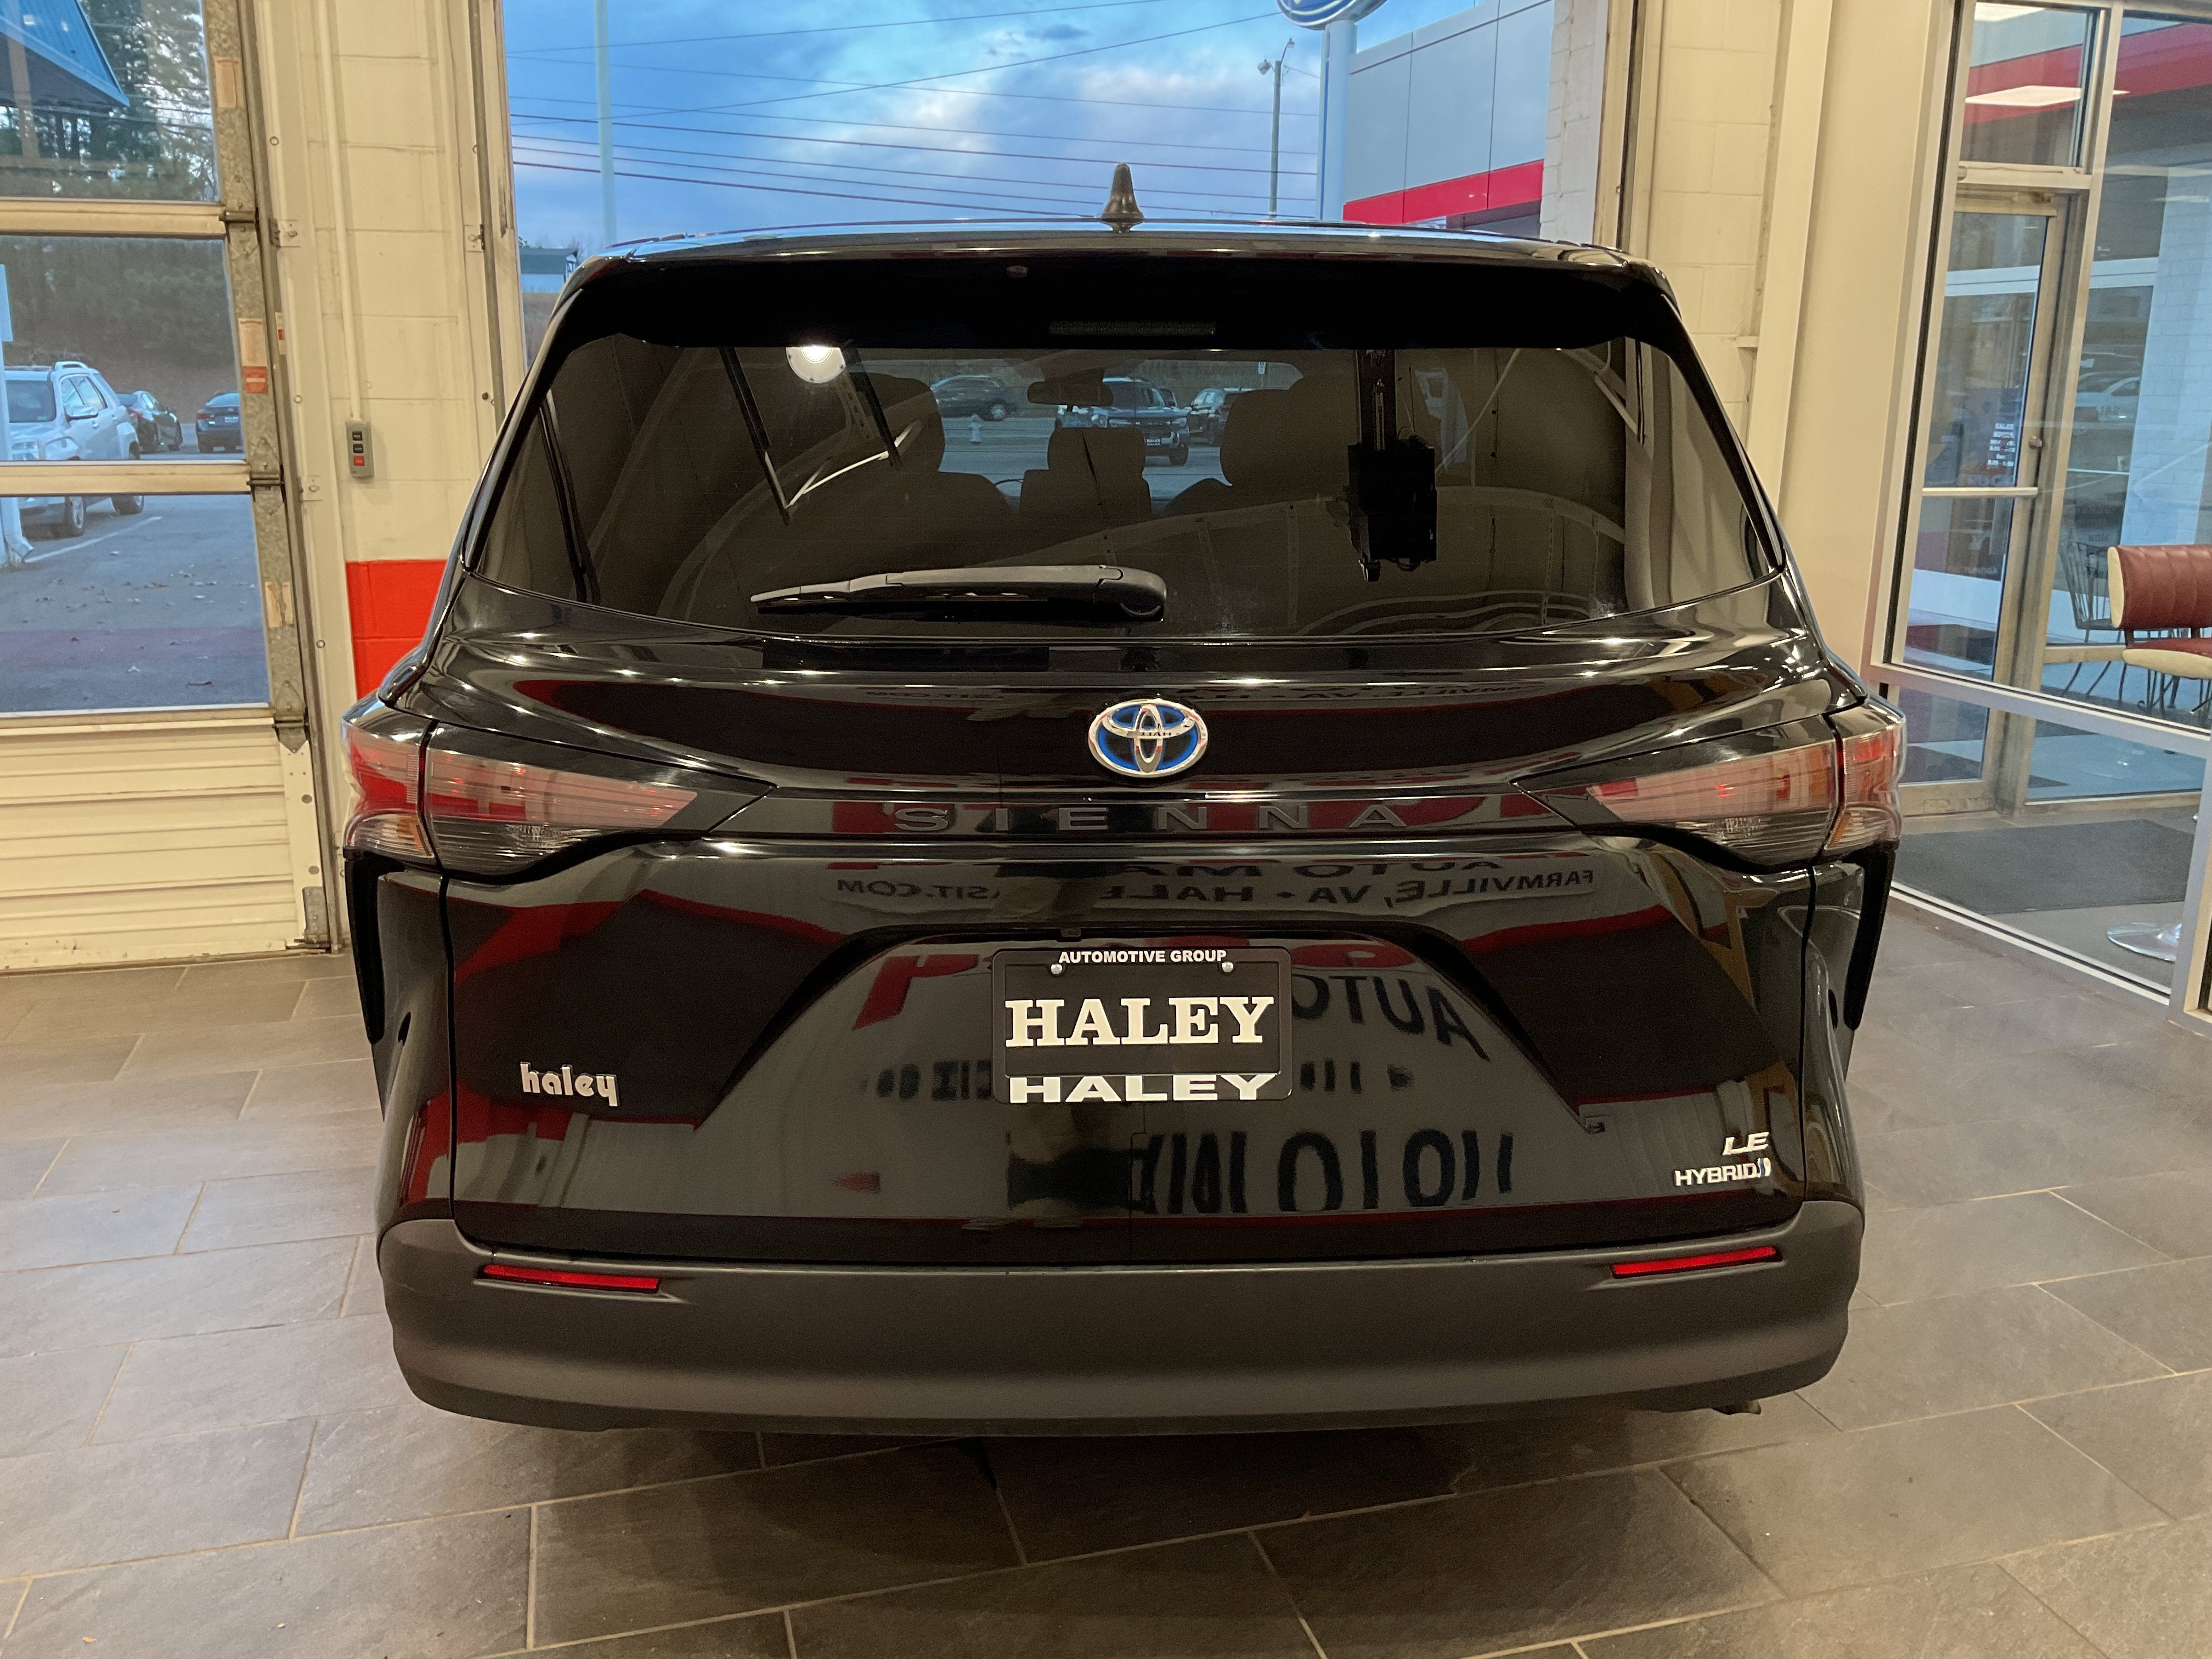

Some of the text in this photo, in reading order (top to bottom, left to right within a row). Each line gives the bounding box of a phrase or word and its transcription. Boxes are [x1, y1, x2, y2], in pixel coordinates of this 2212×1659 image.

[894, 805, 1408, 832] SIENNA
[1058, 949, 1227, 963] AUTOMOTIVE GROUP
[1005, 996, 1274, 1047] HALEY
[520, 1062, 621, 1107] haley
[1009, 1074, 1276, 1103] HALEY
[1722, 1131, 1769, 1156] LE
[1674, 1162, 1761, 1187] HYBRID
